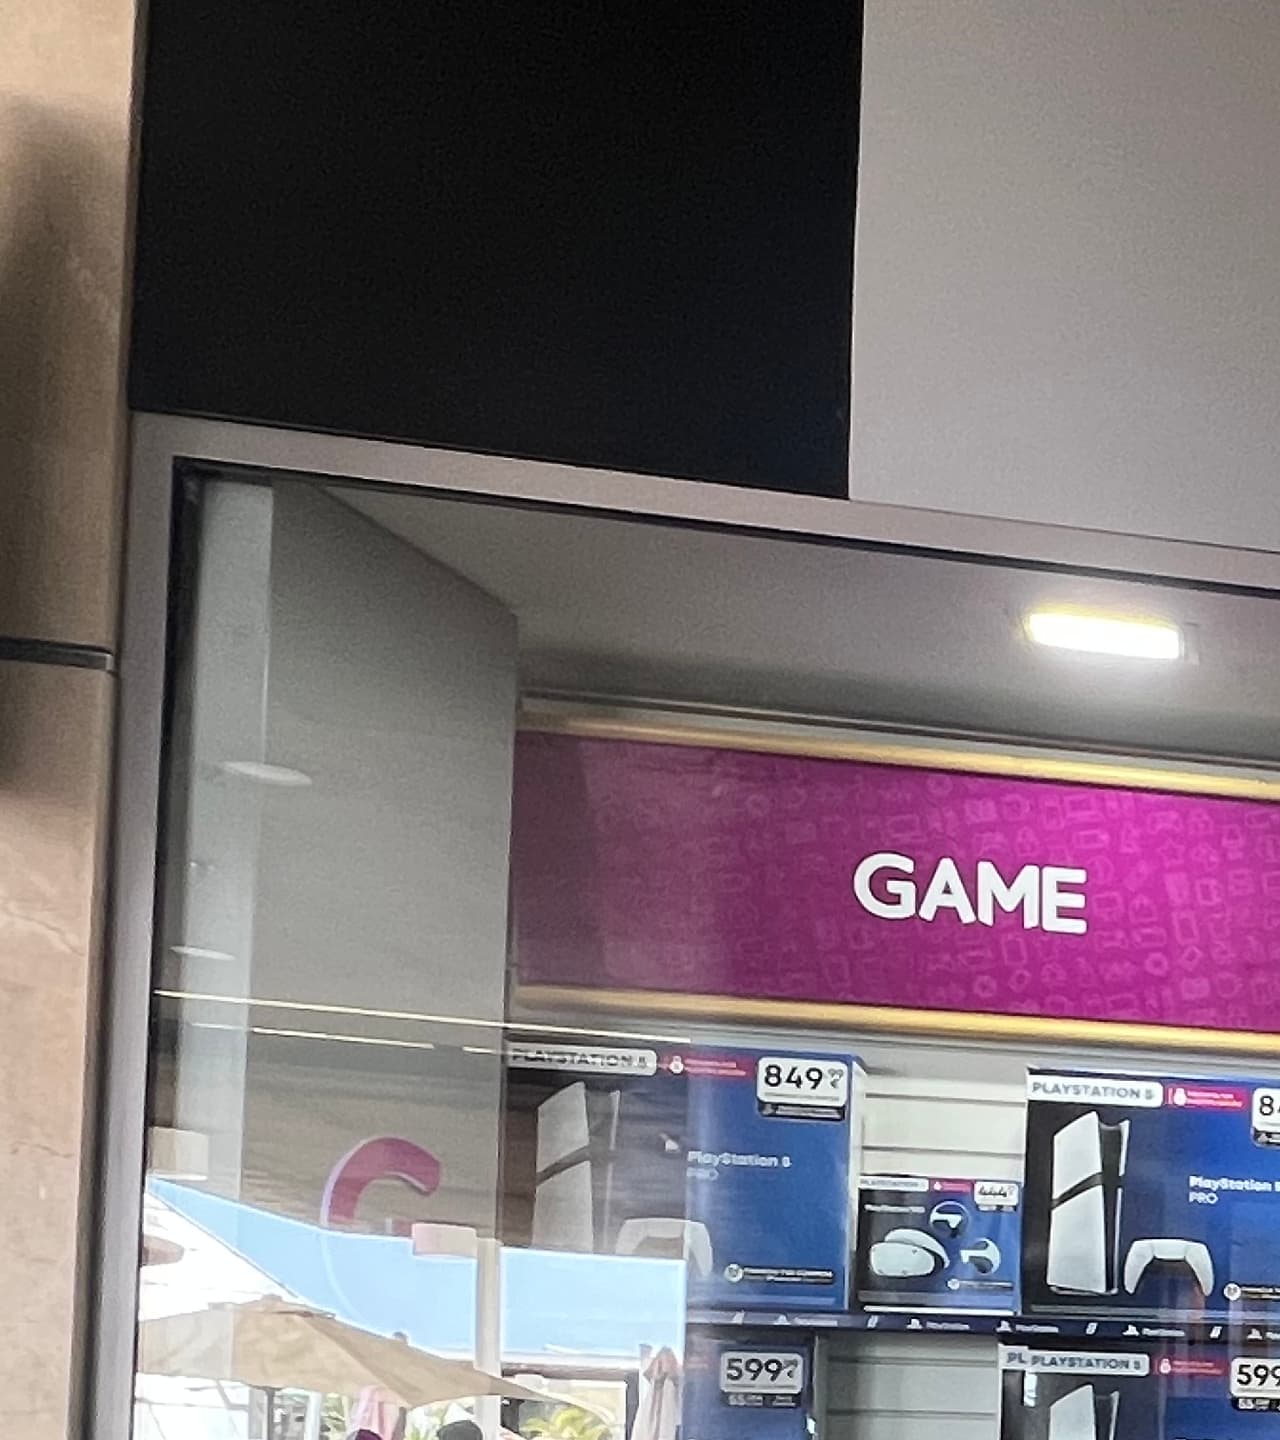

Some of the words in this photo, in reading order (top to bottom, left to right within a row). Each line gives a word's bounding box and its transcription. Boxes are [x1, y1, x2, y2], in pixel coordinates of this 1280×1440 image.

[853, 852, 1088, 934] GAME
[764, 1064, 824, 1090] 849
[1031, 1081, 1142, 1101] PLAYSTATION
[1189, 1175, 1269, 1192] PlayStation
[726, 1357, 782, 1381] 599
[1031, 1355, 1131, 1371] PLAYSTATION
